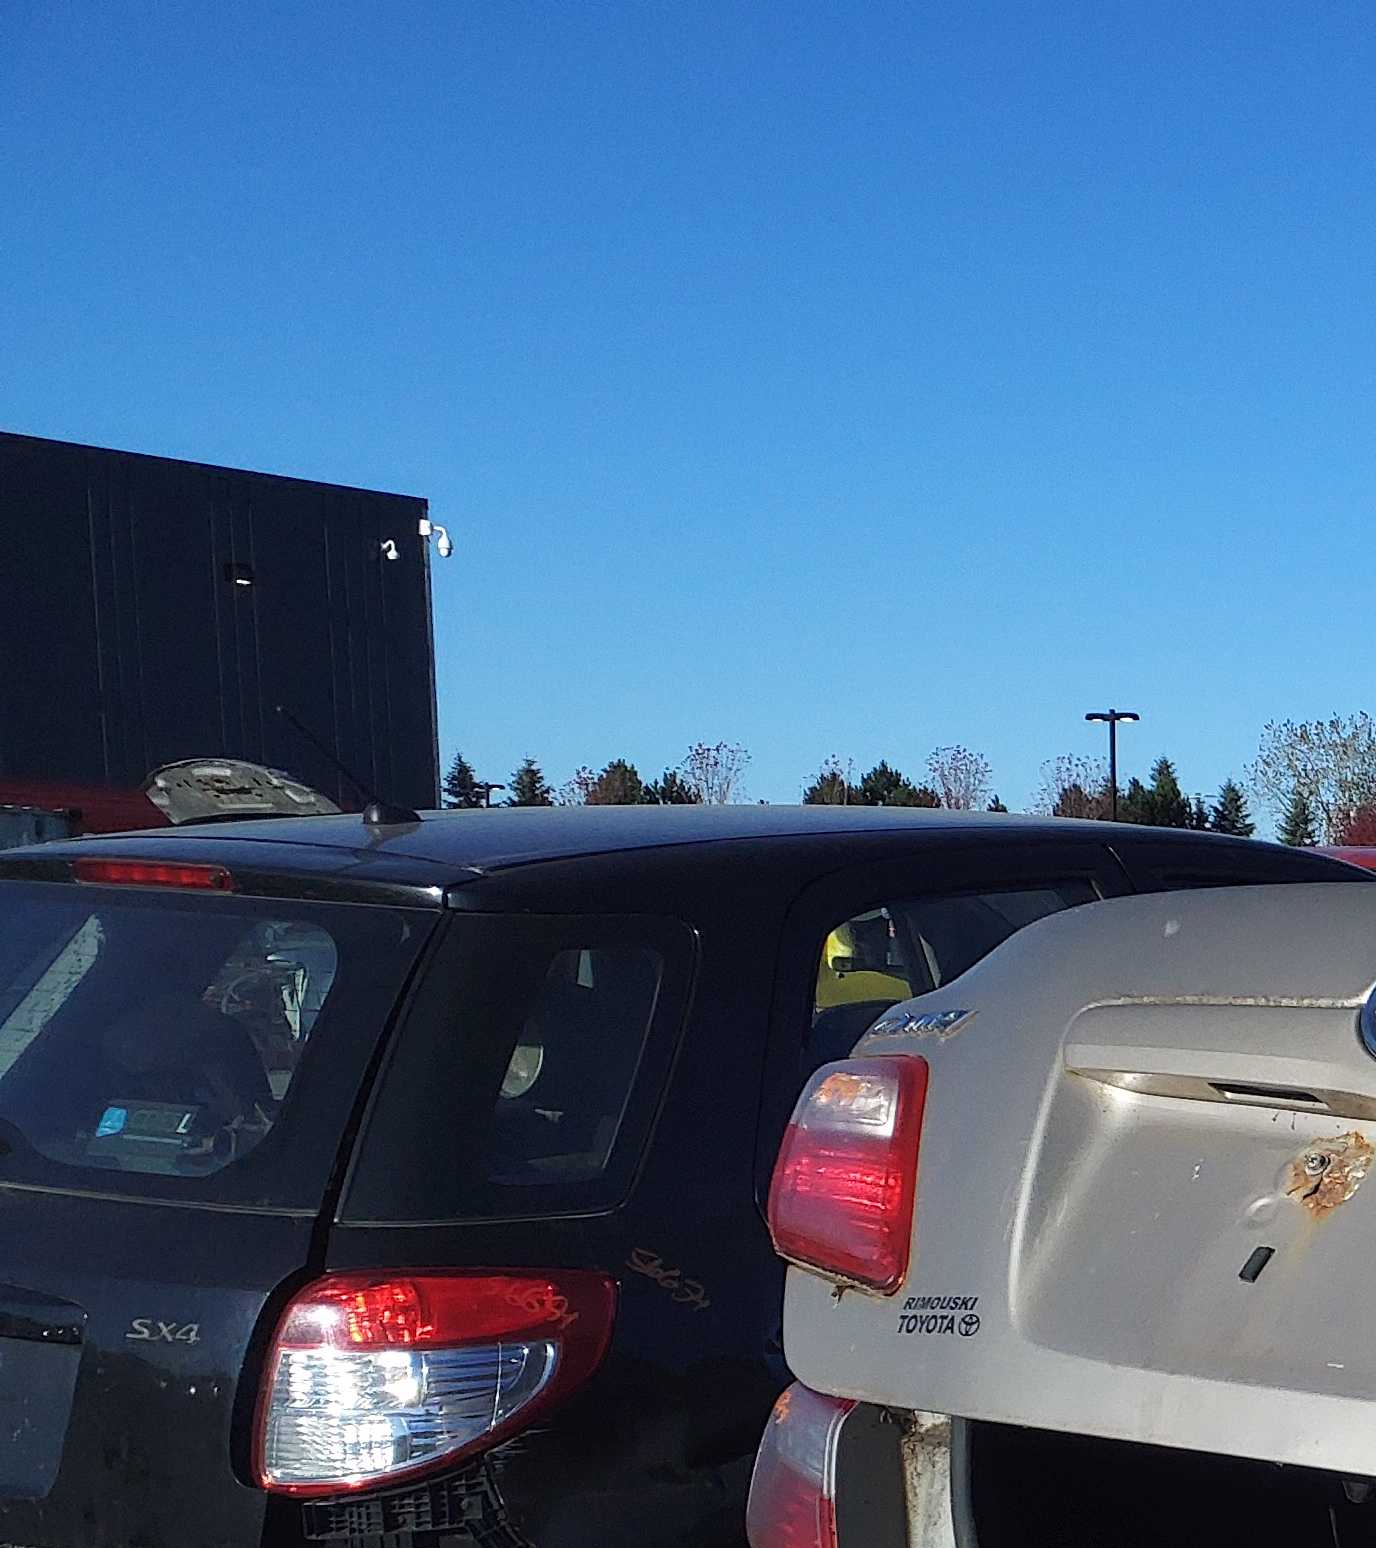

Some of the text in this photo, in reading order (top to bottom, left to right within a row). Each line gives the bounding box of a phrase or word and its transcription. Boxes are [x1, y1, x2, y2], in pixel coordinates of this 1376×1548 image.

[903, 1296, 979, 1310] RIMOUSKI
[126, 1319, 200, 1343] SX4
[897, 1314, 955, 1334] TOYOTA
